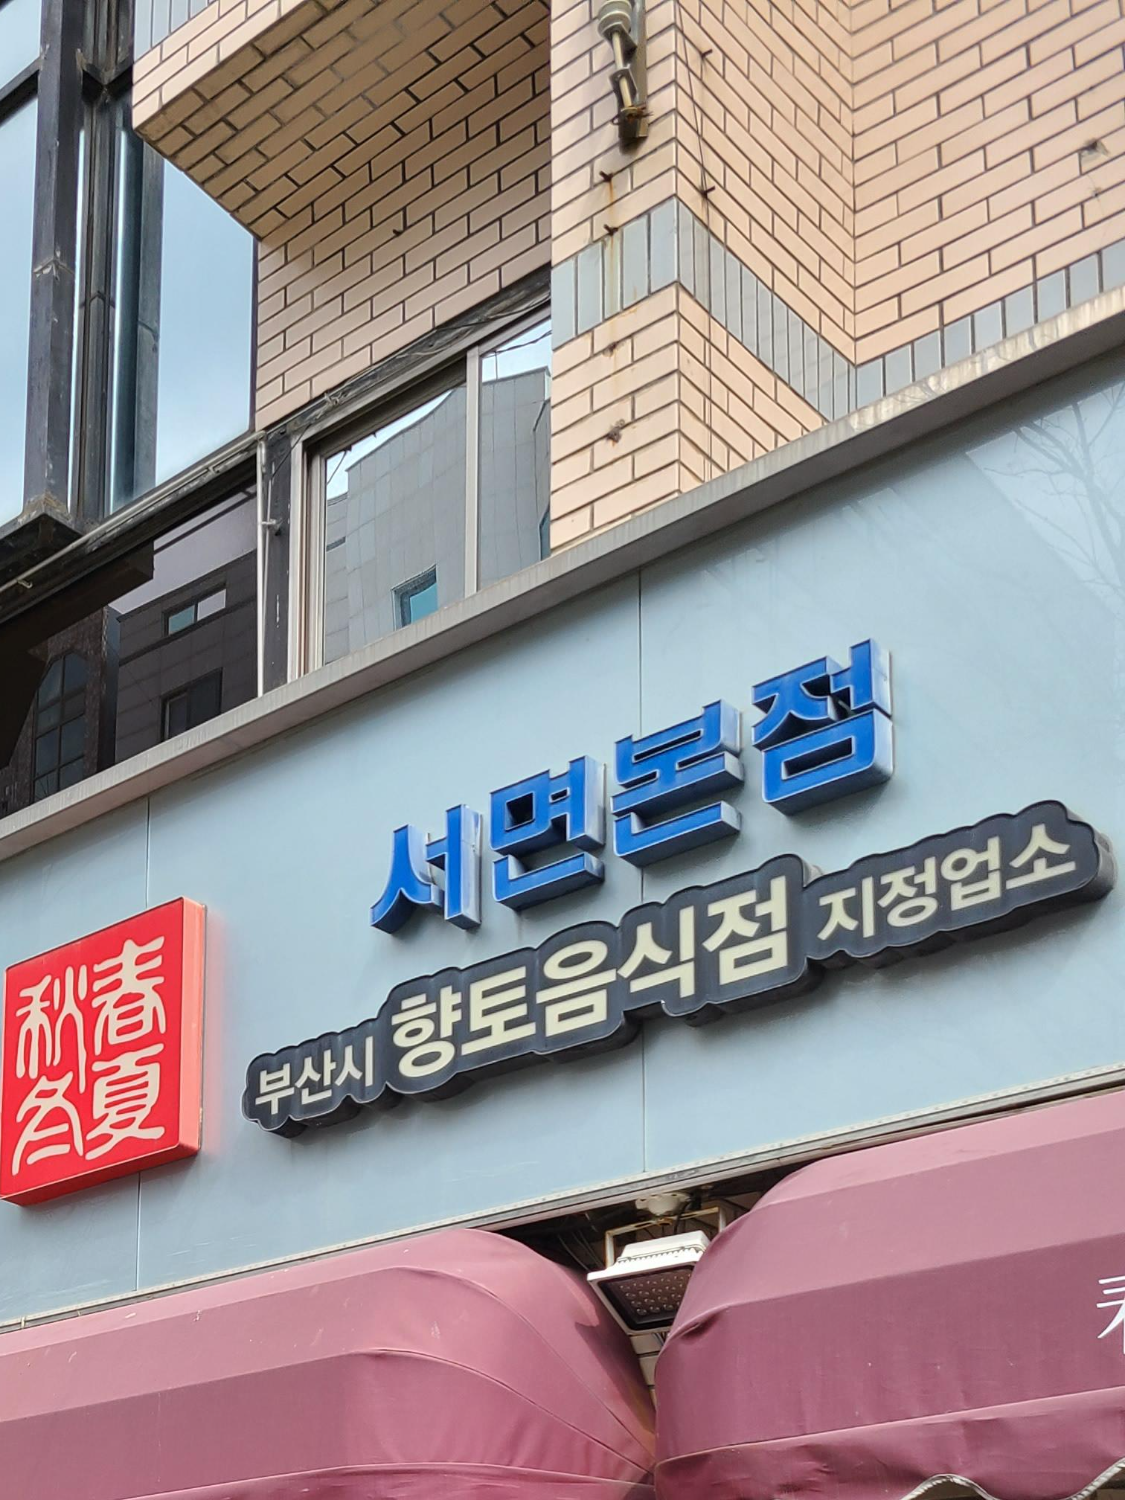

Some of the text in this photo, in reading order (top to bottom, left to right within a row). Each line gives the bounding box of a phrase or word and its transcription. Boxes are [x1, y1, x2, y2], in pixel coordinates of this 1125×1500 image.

[370, 638, 894, 935] 서면본점
[255, 824, 1077, 1116] 부산시 향토음식점 지정업소
